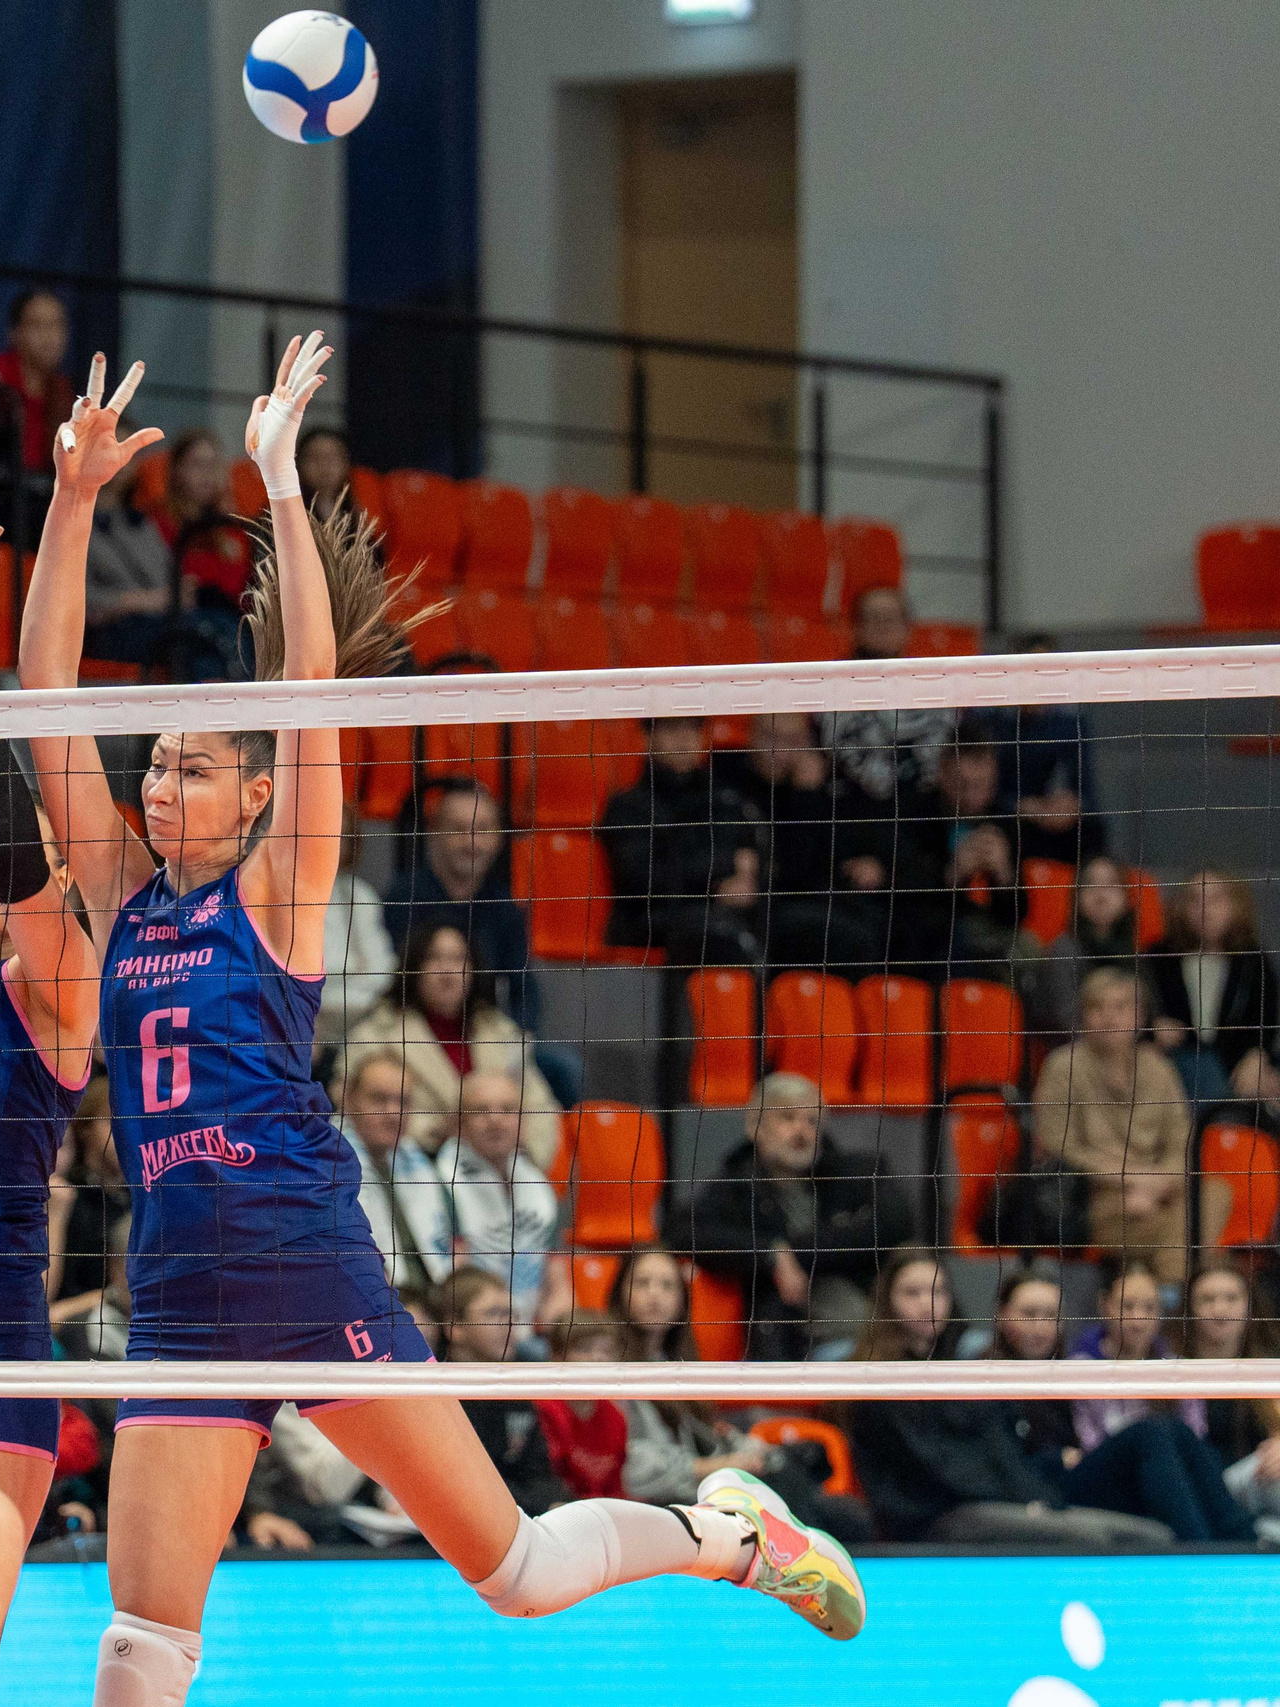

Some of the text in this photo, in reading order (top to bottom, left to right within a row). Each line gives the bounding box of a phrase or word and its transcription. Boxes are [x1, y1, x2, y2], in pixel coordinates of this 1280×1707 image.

[115, 947, 214, 979] ДИНАМО
[128, 971, 190, 990] АК БАРС
[140, 1006, 191, 1113] 6
[344, 1319, 374, 1359] 6
